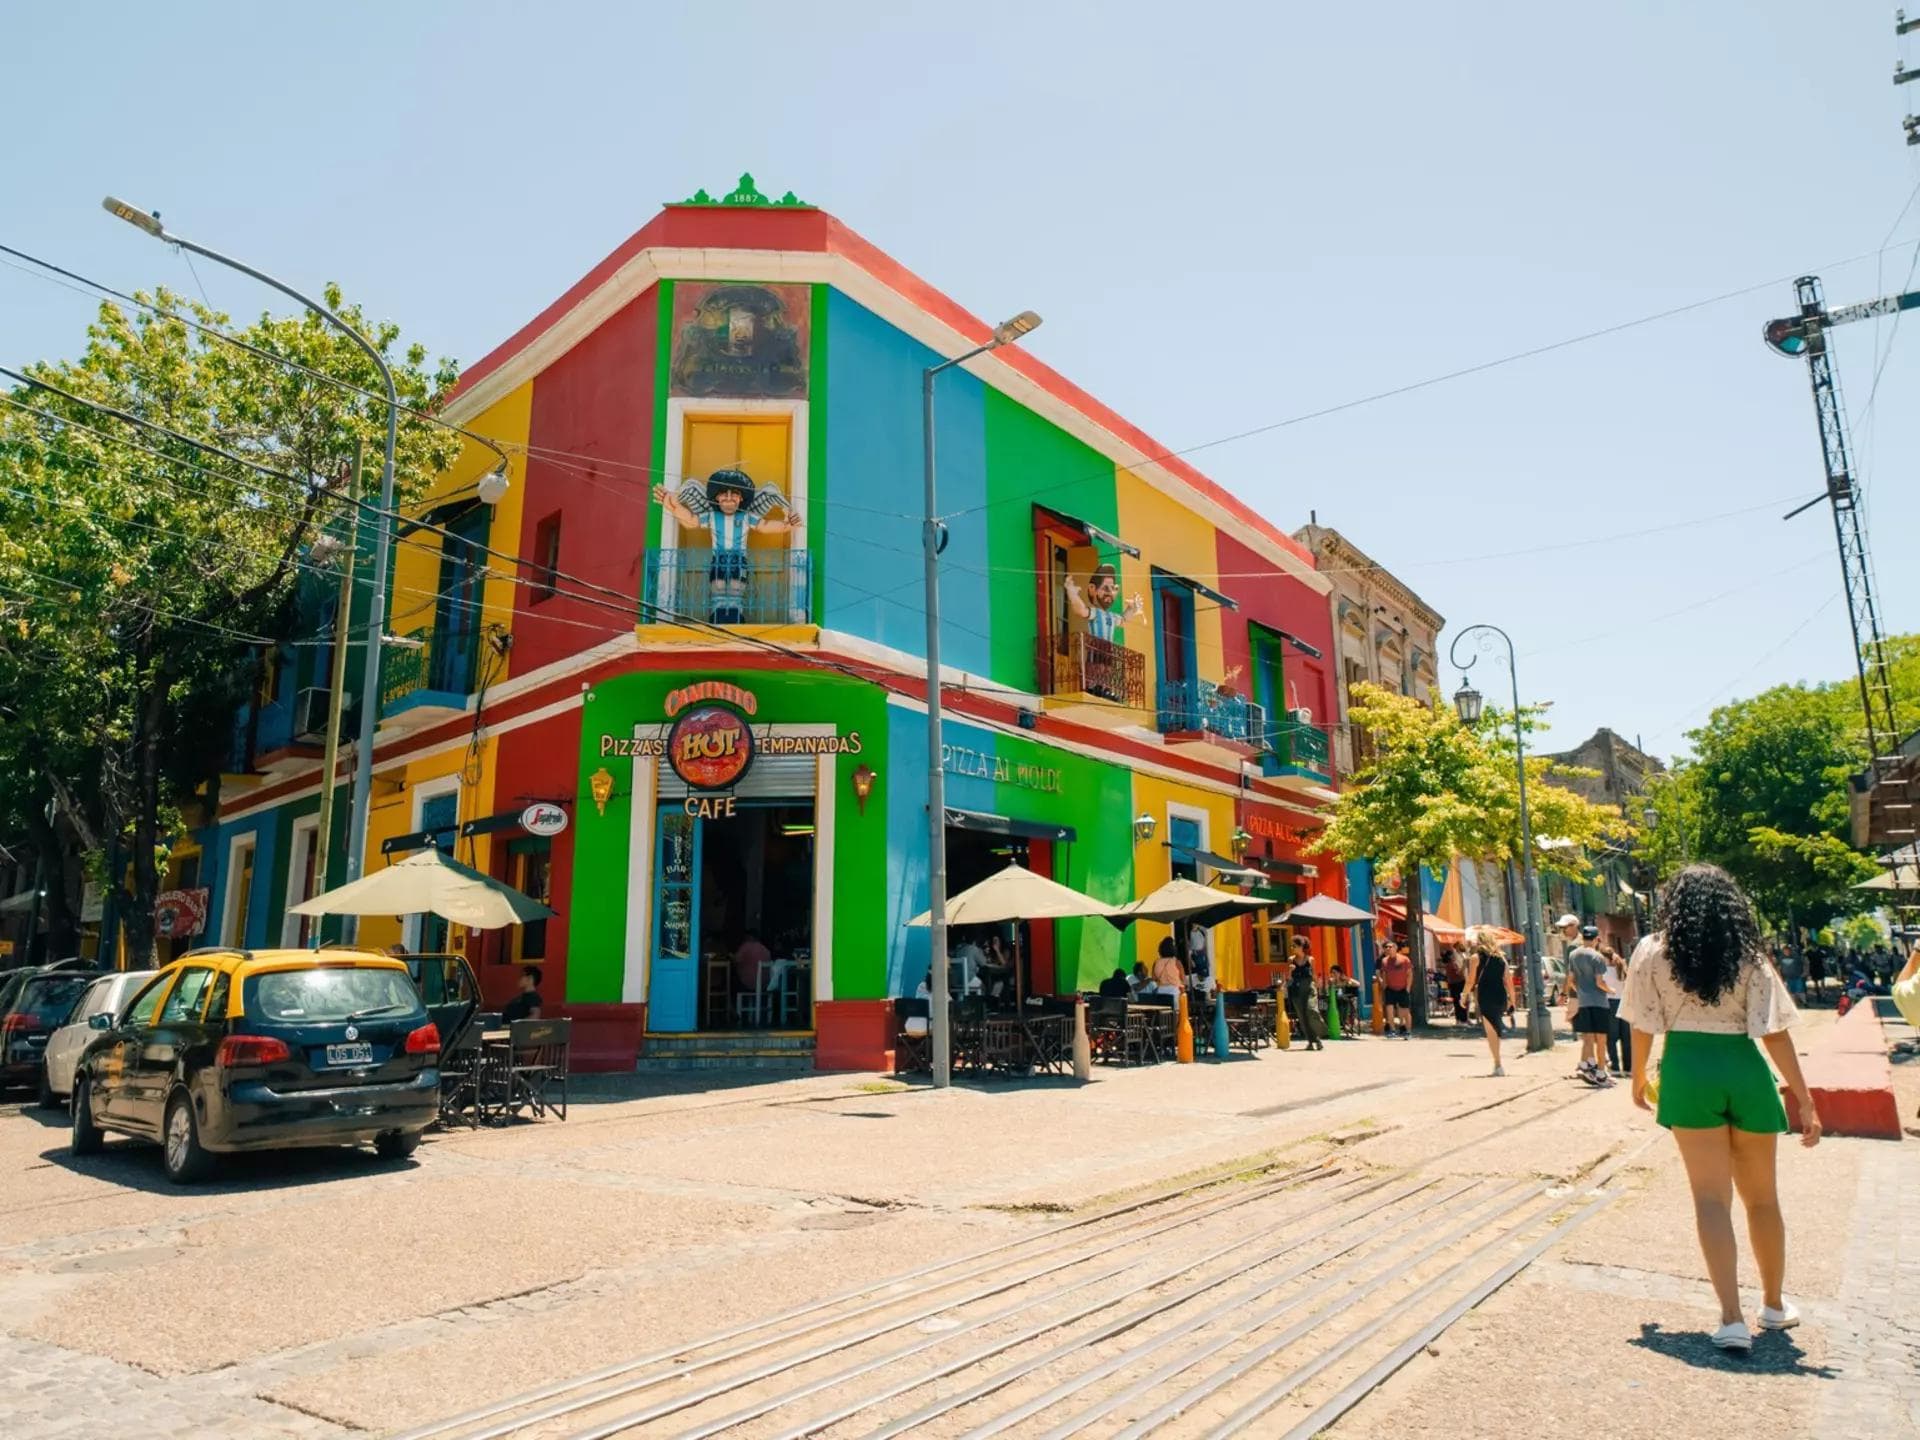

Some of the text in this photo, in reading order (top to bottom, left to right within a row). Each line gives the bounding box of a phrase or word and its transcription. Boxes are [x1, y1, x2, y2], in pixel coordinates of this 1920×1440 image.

[681, 728, 741, 760] HOT
[761, 732, 862, 755] EMPANADAS
[942, 744, 988, 778] PIZZA
